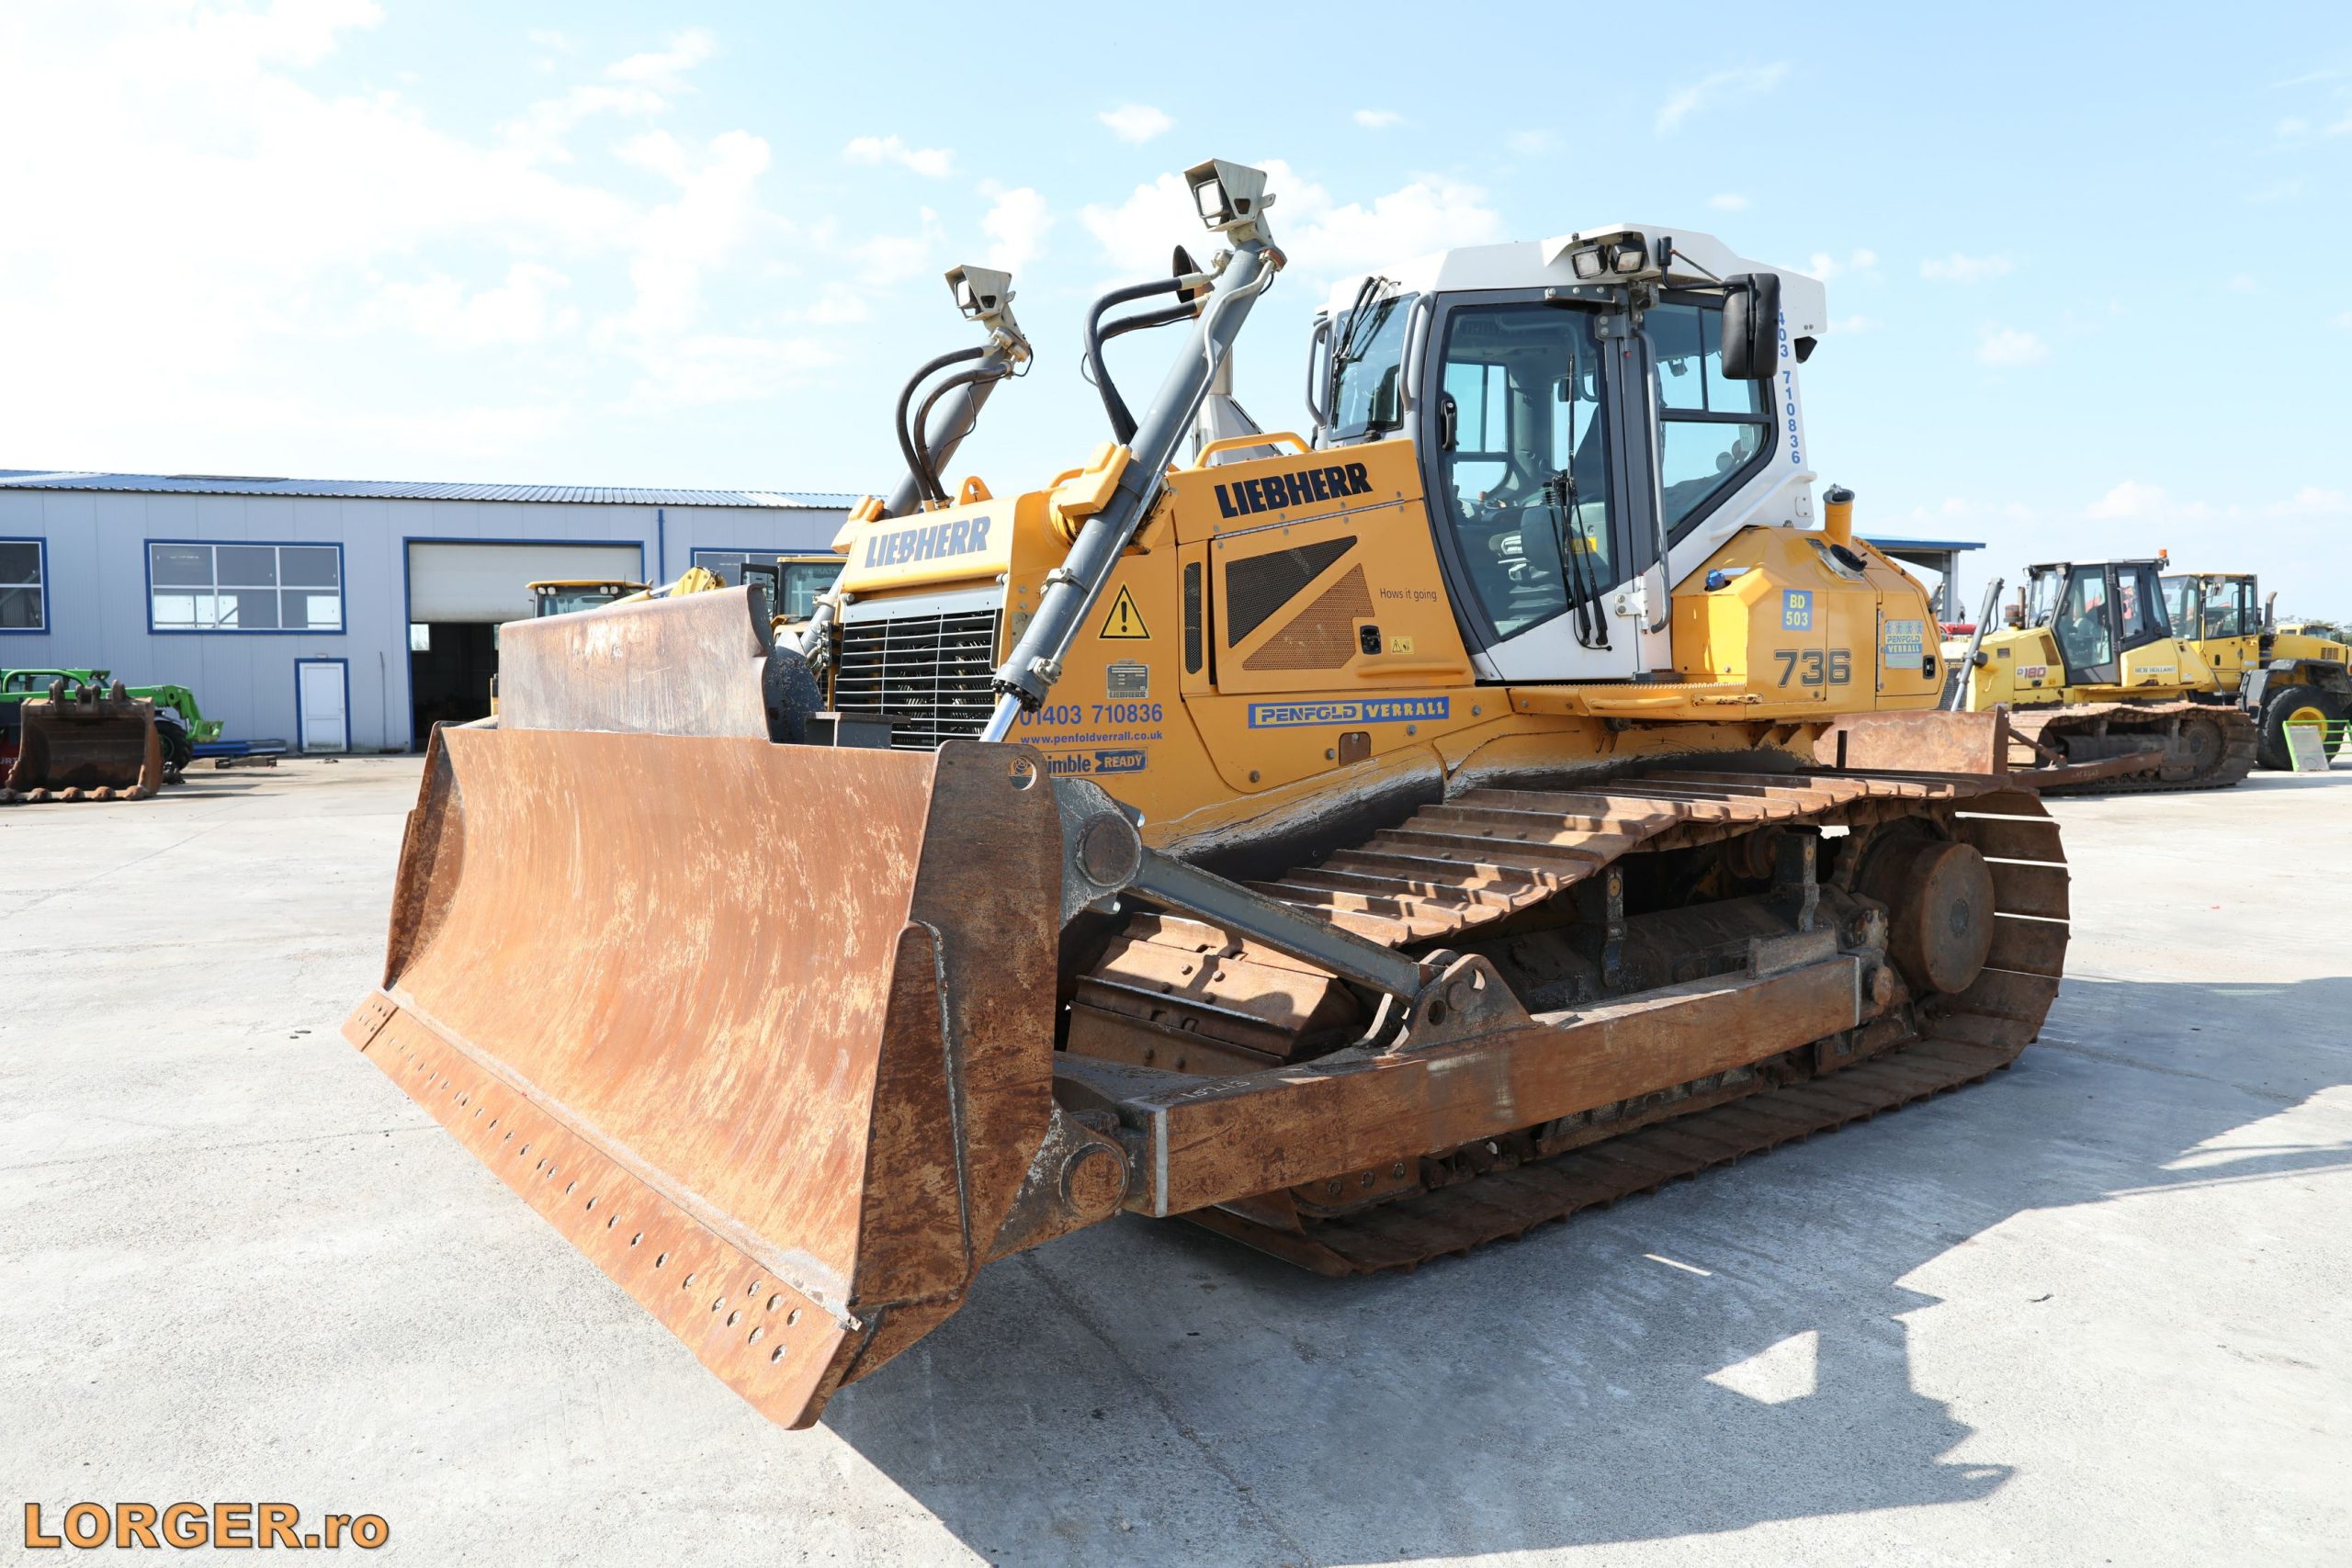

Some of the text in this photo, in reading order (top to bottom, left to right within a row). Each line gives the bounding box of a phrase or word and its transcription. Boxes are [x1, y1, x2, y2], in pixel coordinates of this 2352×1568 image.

[1782, 371, 1801, 464] 710836
[1214, 462, 1374, 518] LIEBHERR
[865, 516, 991, 569] LIEBHERR
[1380, 588, 1437, 602] Hows it going
[1790, 594, 1805, 609] BD
[1786, 612, 1808, 626] 503
[1888, 645, 1919, 653] VERRALL
[1774, 649, 1851, 687] 736
[1019, 704, 1163, 726] 01403 710836
[1261, 702, 1445, 722] PENFOLD VERRALL
[1021, 730, 1162, 745] www.penfoldverrall.co.uk
[1104, 756, 1142, 768] READY
